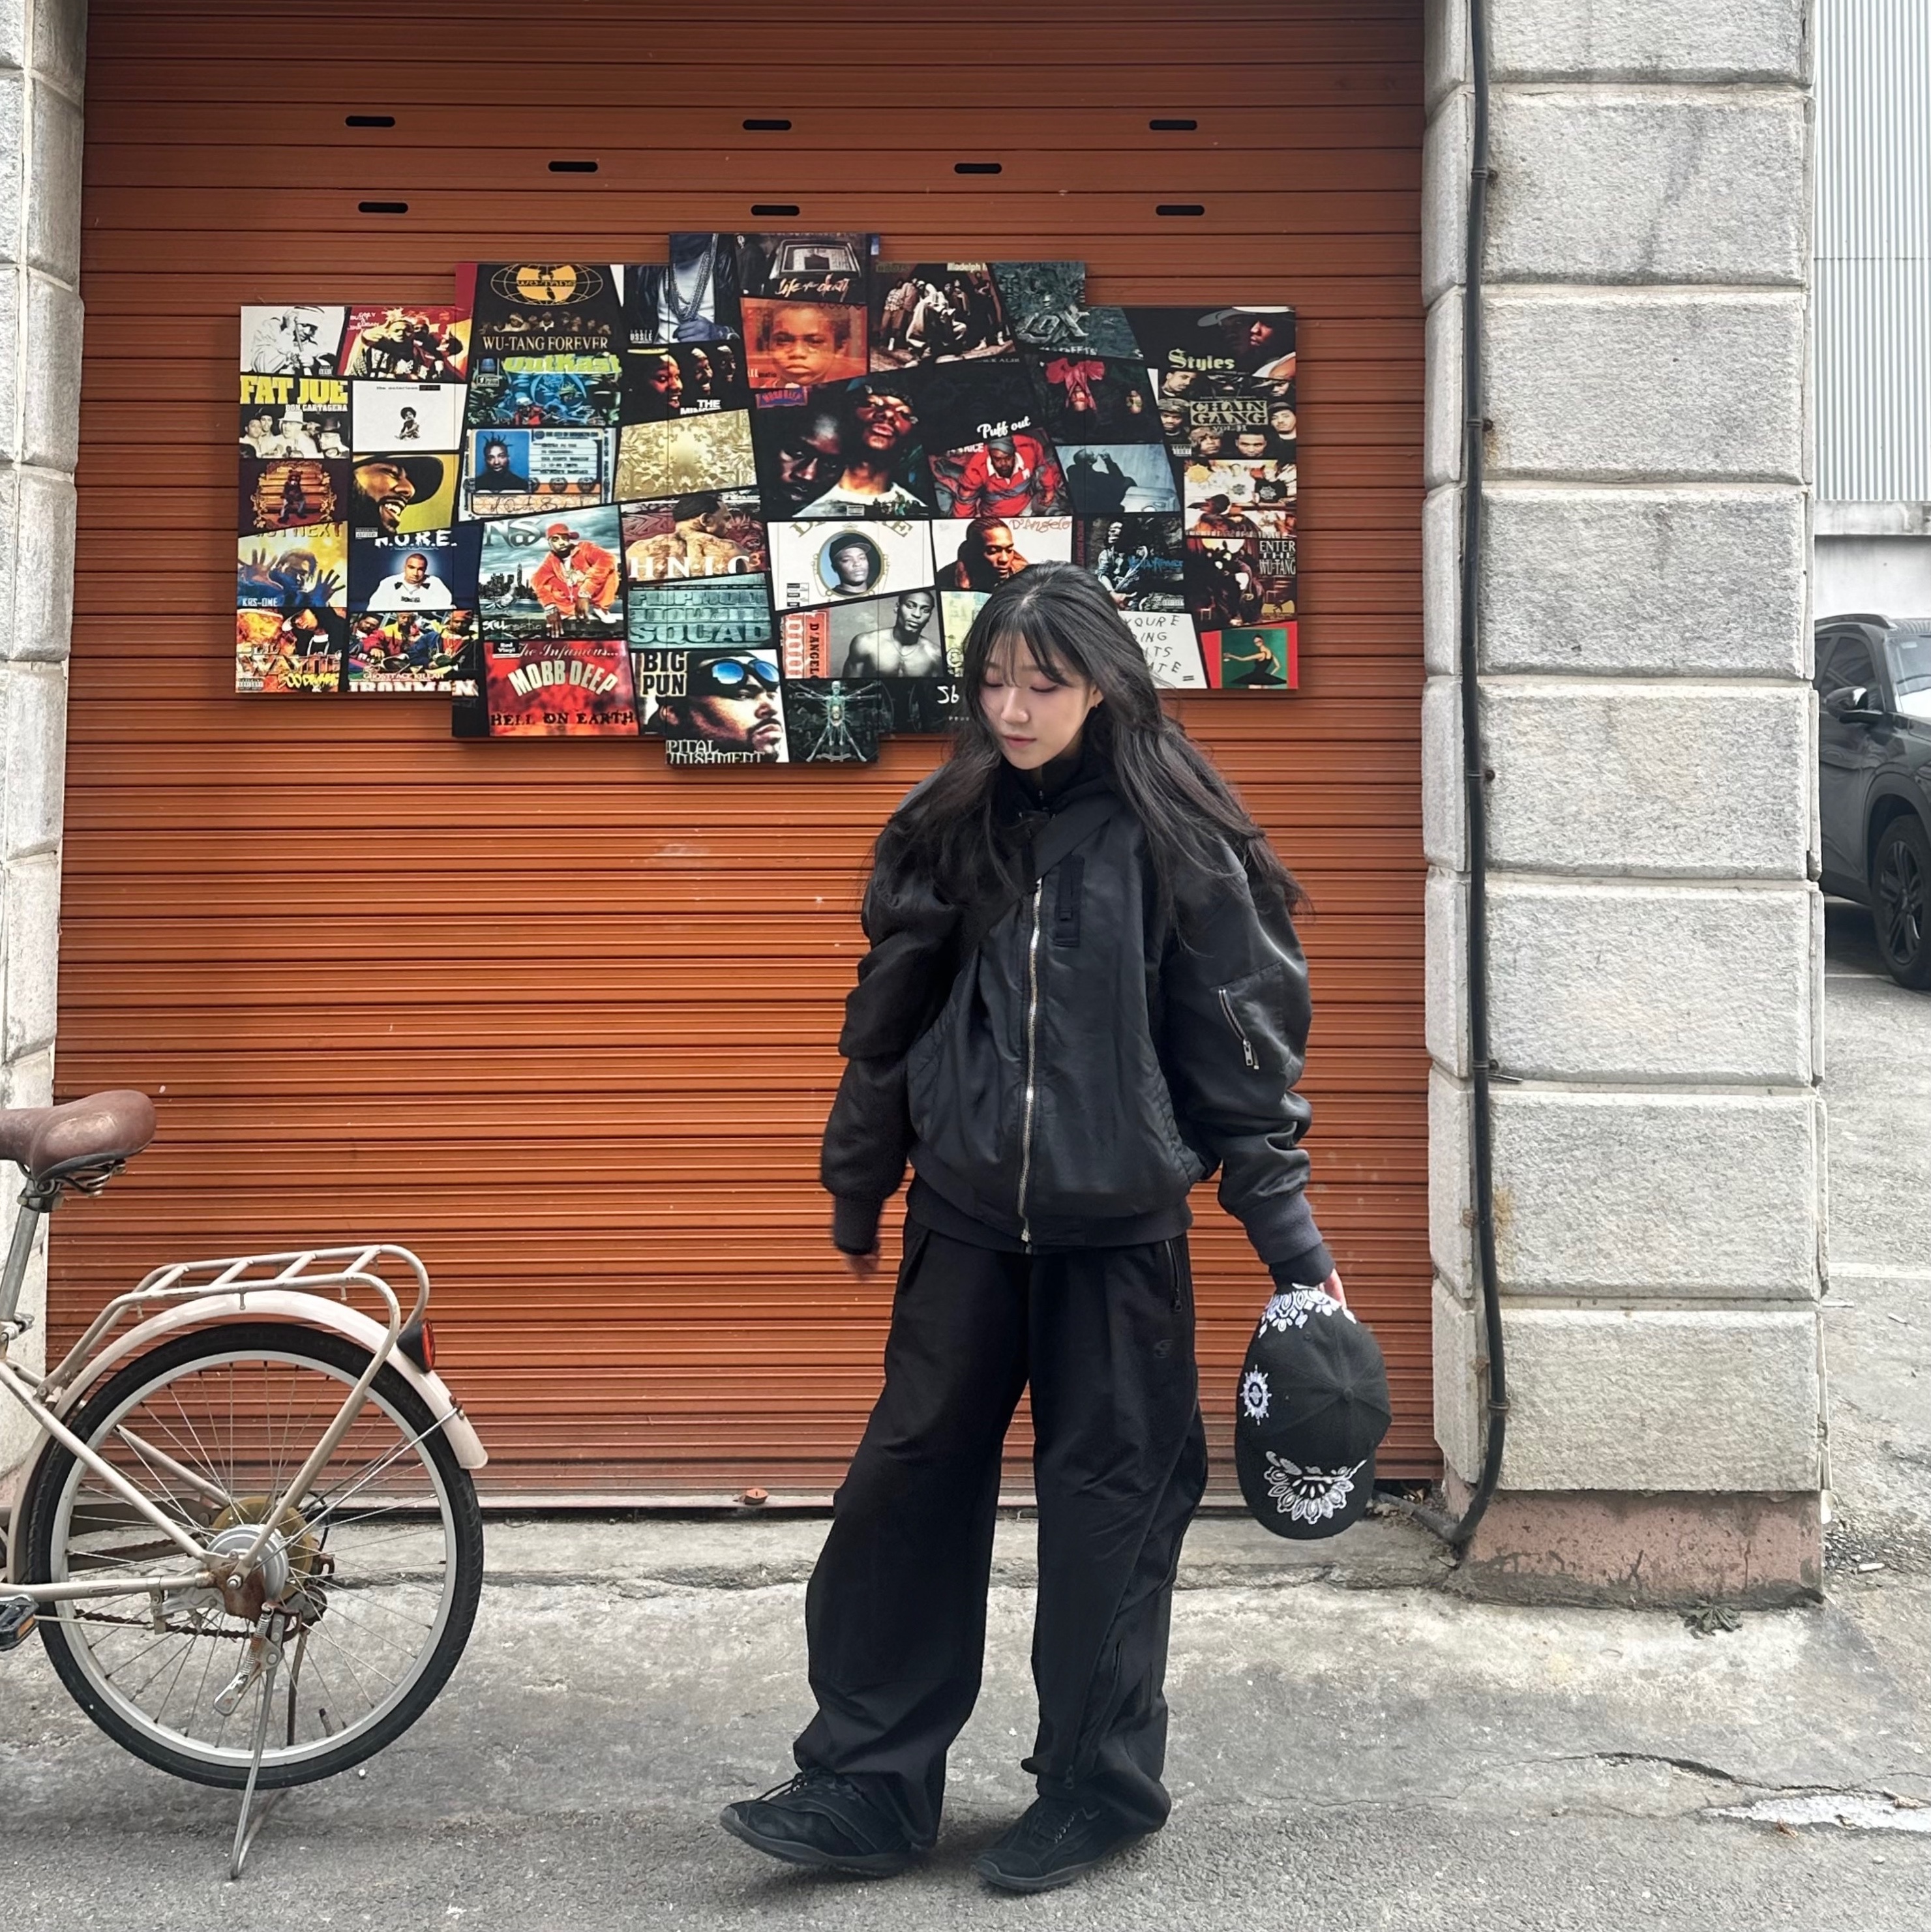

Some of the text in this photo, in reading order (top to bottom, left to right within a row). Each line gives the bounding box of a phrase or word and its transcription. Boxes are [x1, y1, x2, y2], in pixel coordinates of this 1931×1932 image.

[483, 336, 608, 351] WU-TANG FOREVER
[1168, 348, 1235, 371] Styles
[239, 375, 293, 404] FAT
[696, 399, 721, 408] THE
[1191, 401, 1265, 412] CHAIN
[1192, 412, 1266, 424] GANG
[976, 416, 1031, 439] Puff out
[1009, 517, 1071, 533] D'Angelo
[1259, 541, 1296, 552] ENTER
[242, 597, 278, 607] KRS-ONE
[629, 623, 771, 644] SQUAD
[809, 623, 820, 678] D'ANGEL
[642, 653, 687, 672] BIG
[507, 660, 618, 696] MOBB DEEP
[642, 674, 686, 695] PUN
[491, 714, 535, 726] HELL
[576, 711, 634, 724] EARTH
